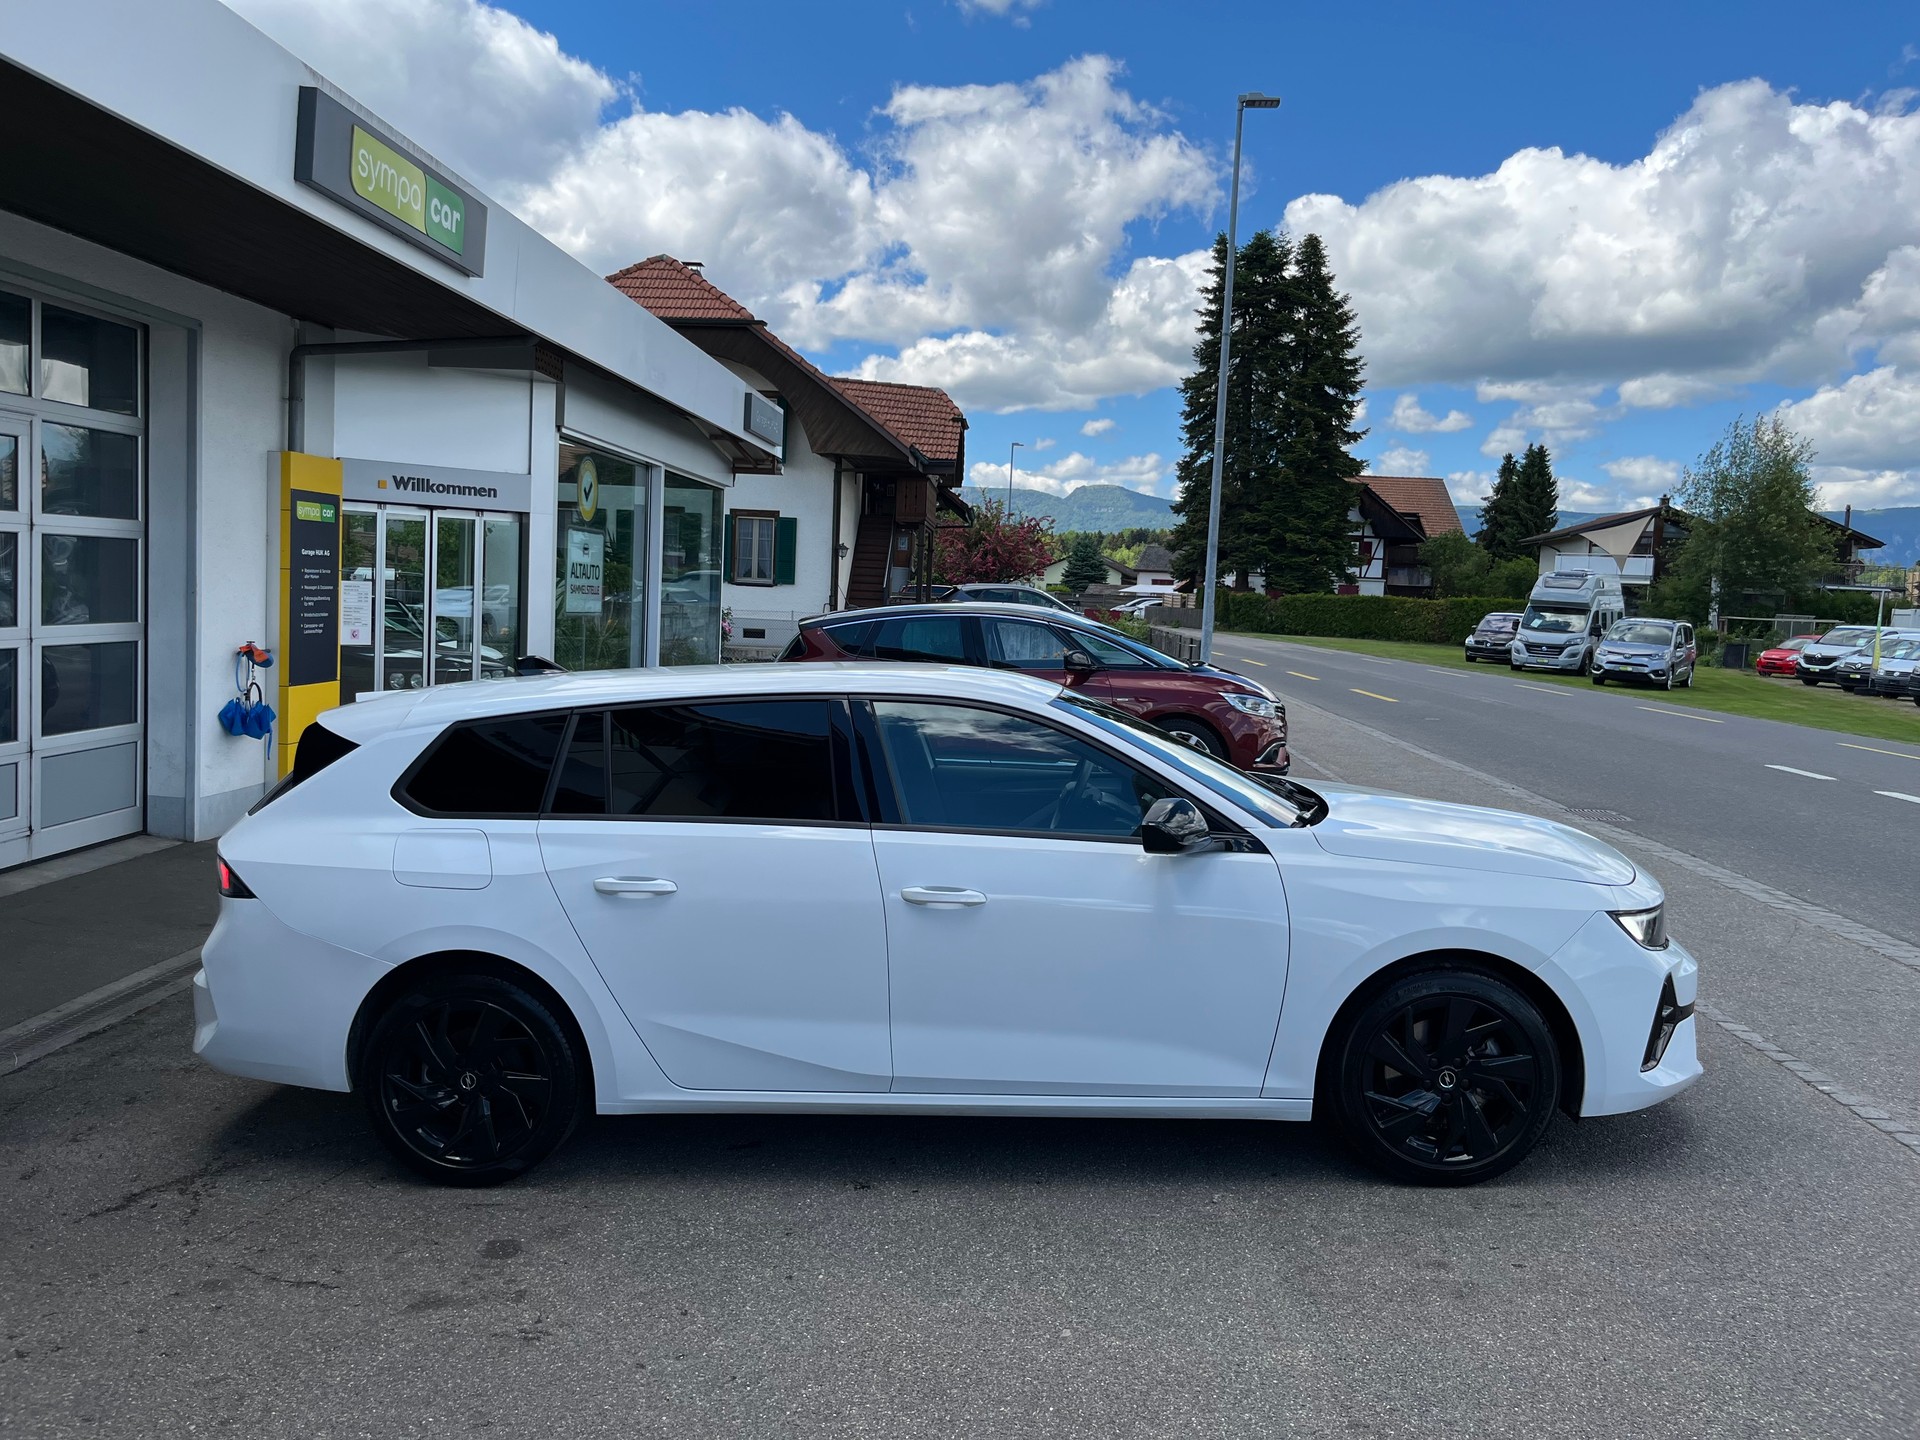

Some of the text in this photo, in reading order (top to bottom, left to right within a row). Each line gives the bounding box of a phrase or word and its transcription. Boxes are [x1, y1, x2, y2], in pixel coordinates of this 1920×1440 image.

[358, 149, 461, 233] sympa car
[392, 475, 498, 498] Willkommen
[298, 506, 334, 518] sympa car
[301, 548, 315, 556] Garage
[570, 562, 600, 580] ALTAUTO
